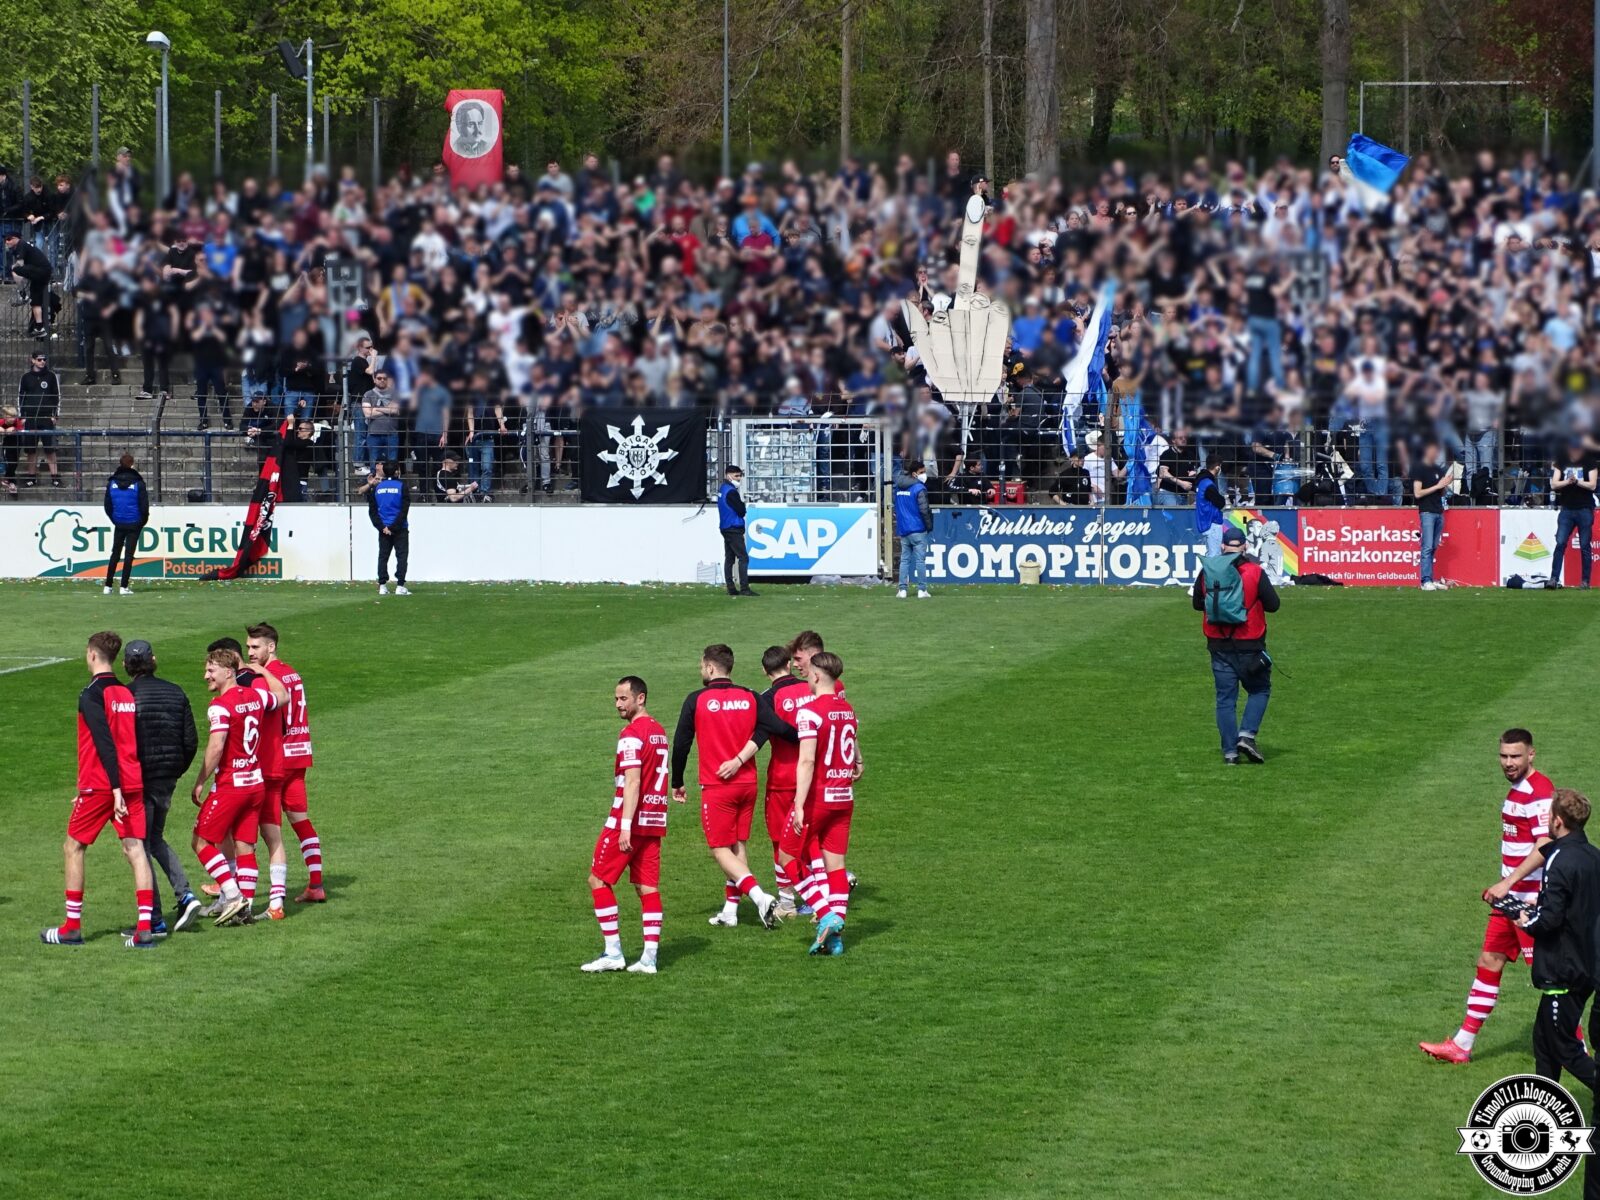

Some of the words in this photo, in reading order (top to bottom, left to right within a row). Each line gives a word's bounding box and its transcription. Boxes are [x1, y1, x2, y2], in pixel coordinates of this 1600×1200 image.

[619, 435, 657, 456] BRIGADA
[72, 521, 279, 552] STDTGRÜ
[747, 518, 838, 559] SAP
[980, 513, 1074, 536] Nulldrei
[1082, 520, 1152, 542] gegen
[1303, 526, 1336, 542] Das
[1341, 526, 1449, 545] Sparkass-
[246, 560, 279, 574] mbH
[1303, 546, 1436, 566] Finanzkonzep.
[1344, 572, 1355, 580] für
[1356, 572, 1376, 580] Ihren
[1377, 572, 1419, 580] Geldbeutel.
[286, 683, 306, 725] 17
[722, 699, 750, 711] JAKO
[242, 715, 259, 755] 6
[824, 723, 855, 766] 16
[654, 748, 669, 792] 7
